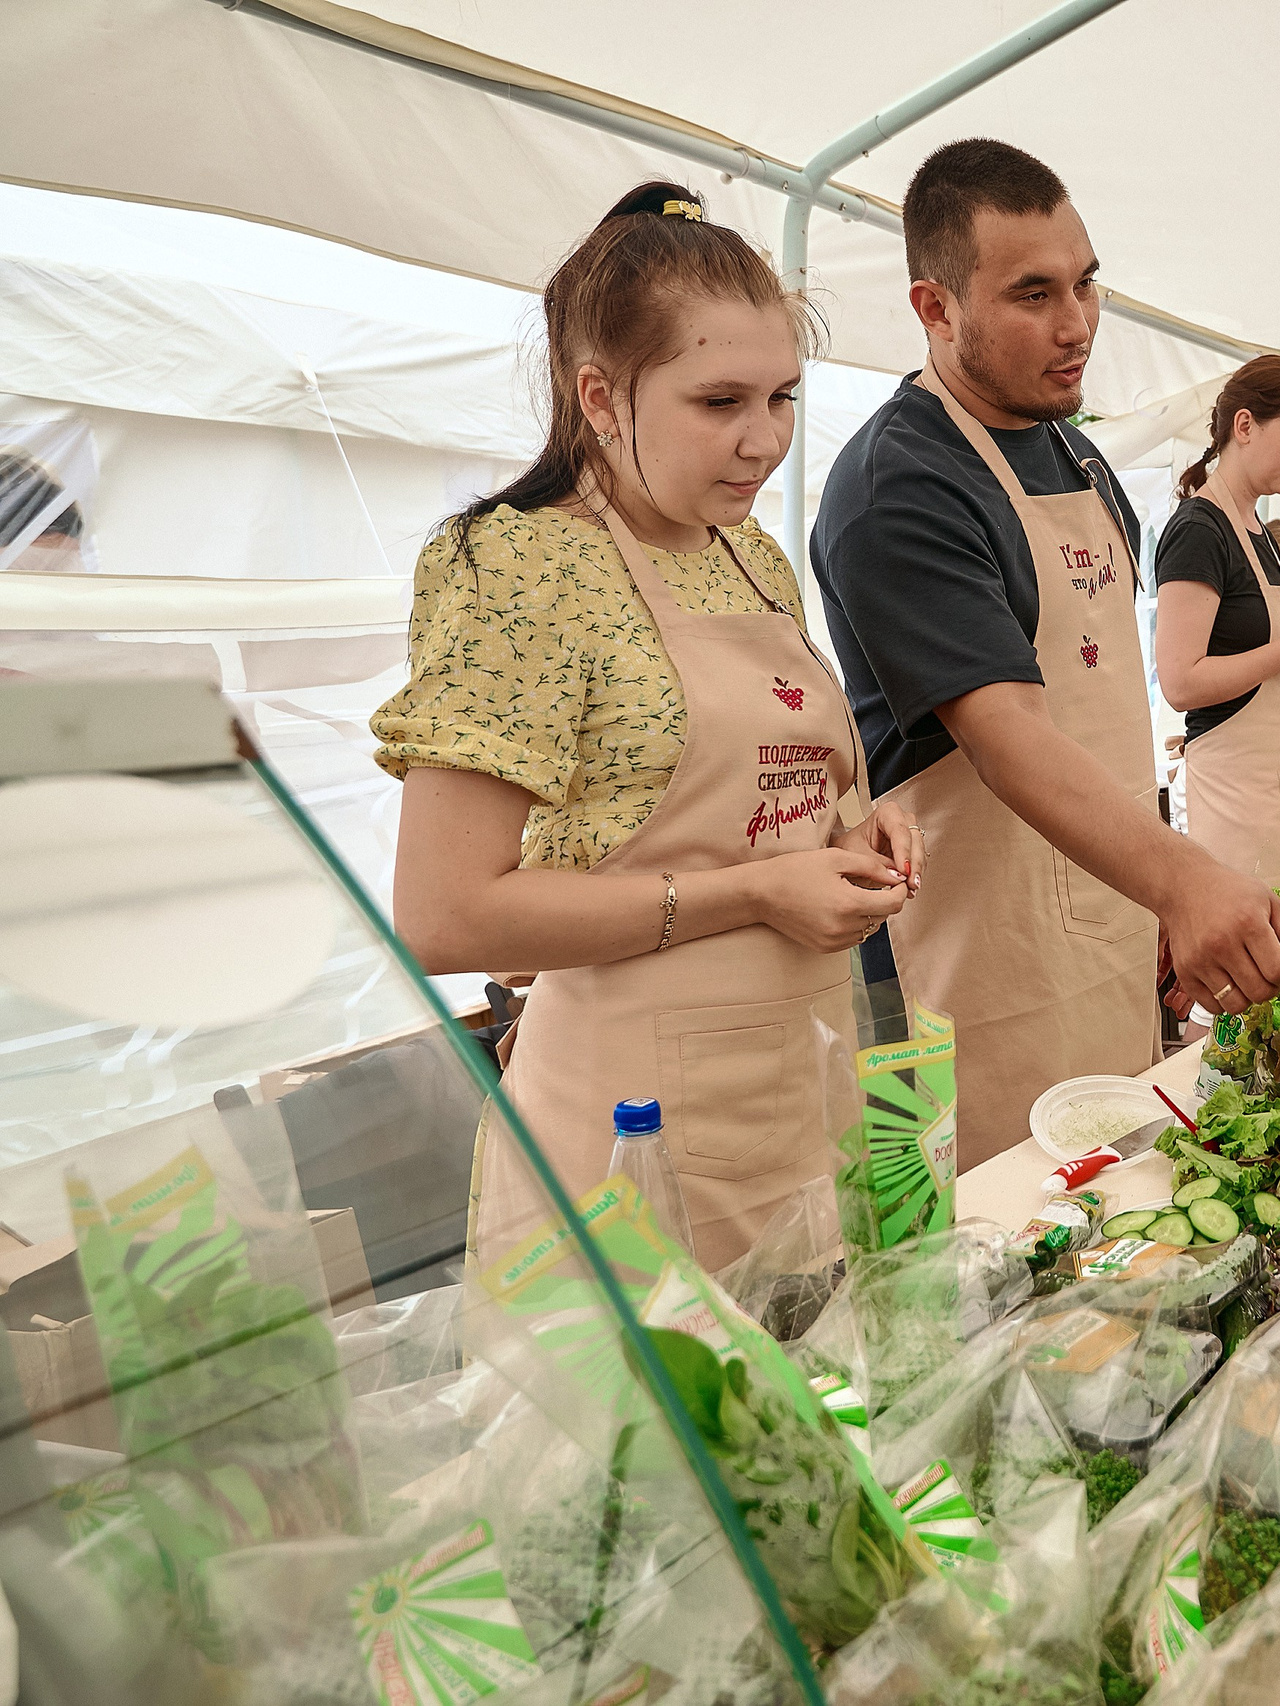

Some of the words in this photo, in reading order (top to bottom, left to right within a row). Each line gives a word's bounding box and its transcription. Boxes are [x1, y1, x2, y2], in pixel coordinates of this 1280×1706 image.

[758, 744, 835, 767] ПОДДЕРЖИ
[758, 768, 825, 791] СИБИРСКИХ
[746, 771, 831, 847] фермеров!
[866, 1049, 920, 1068] Аромат
[922, 1040, 953, 1057] лета
